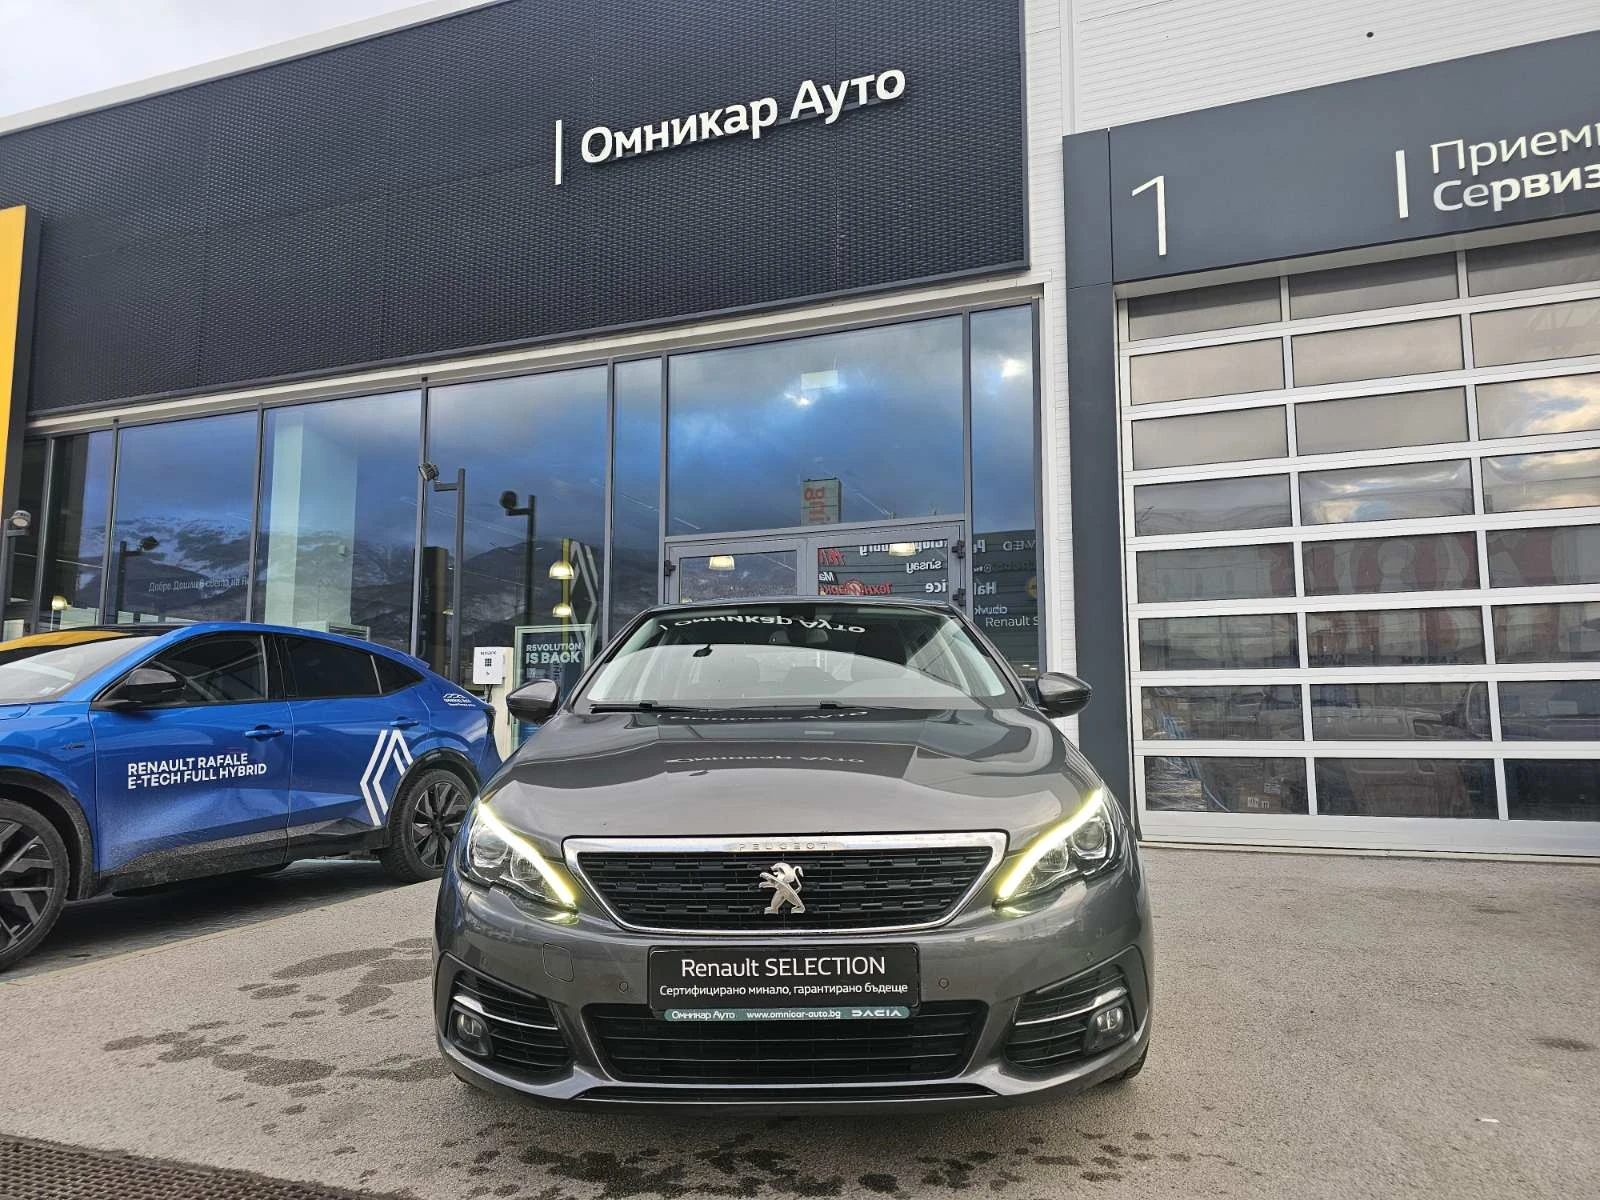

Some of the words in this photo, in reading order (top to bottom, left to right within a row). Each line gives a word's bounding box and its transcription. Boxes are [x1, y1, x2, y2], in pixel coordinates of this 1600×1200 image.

[581, 97, 778, 163] Омникар
[790, 69, 906, 124] Ауто
[1131, 175, 1167, 256] 1
[985, 615, 1030, 627] Renault
[526, 643, 583, 652] R5VOLUTION
[526, 652, 539, 664] IS
[541, 651, 580, 664] BACK
[127, 757, 196, 776] RENAULT
[197, 753, 248, 769] RAFALE
[127, 773, 181, 790] E-TECH
[183, 768, 217, 783] FULL
[219, 763, 267, 779] HYBRID
[739, 842, 828, 851] PEUGEOT
[681, 958, 760, 977] Renault
[765, 956, 885, 976] SELECTION
[660, 985, 746, 997] Сертифицирано
[748, 986, 792, 996] минало,
[794, 984, 862, 996] гарантирано
[864, 982, 908, 994] бъдеще
[671, 1010, 712, 1020] Омникар
[713, 1010, 736, 1020] Ауто
[746, 1009, 841, 1019] www.omnicar-auto.bg
[851, 1009, 902, 1017] DACIA
